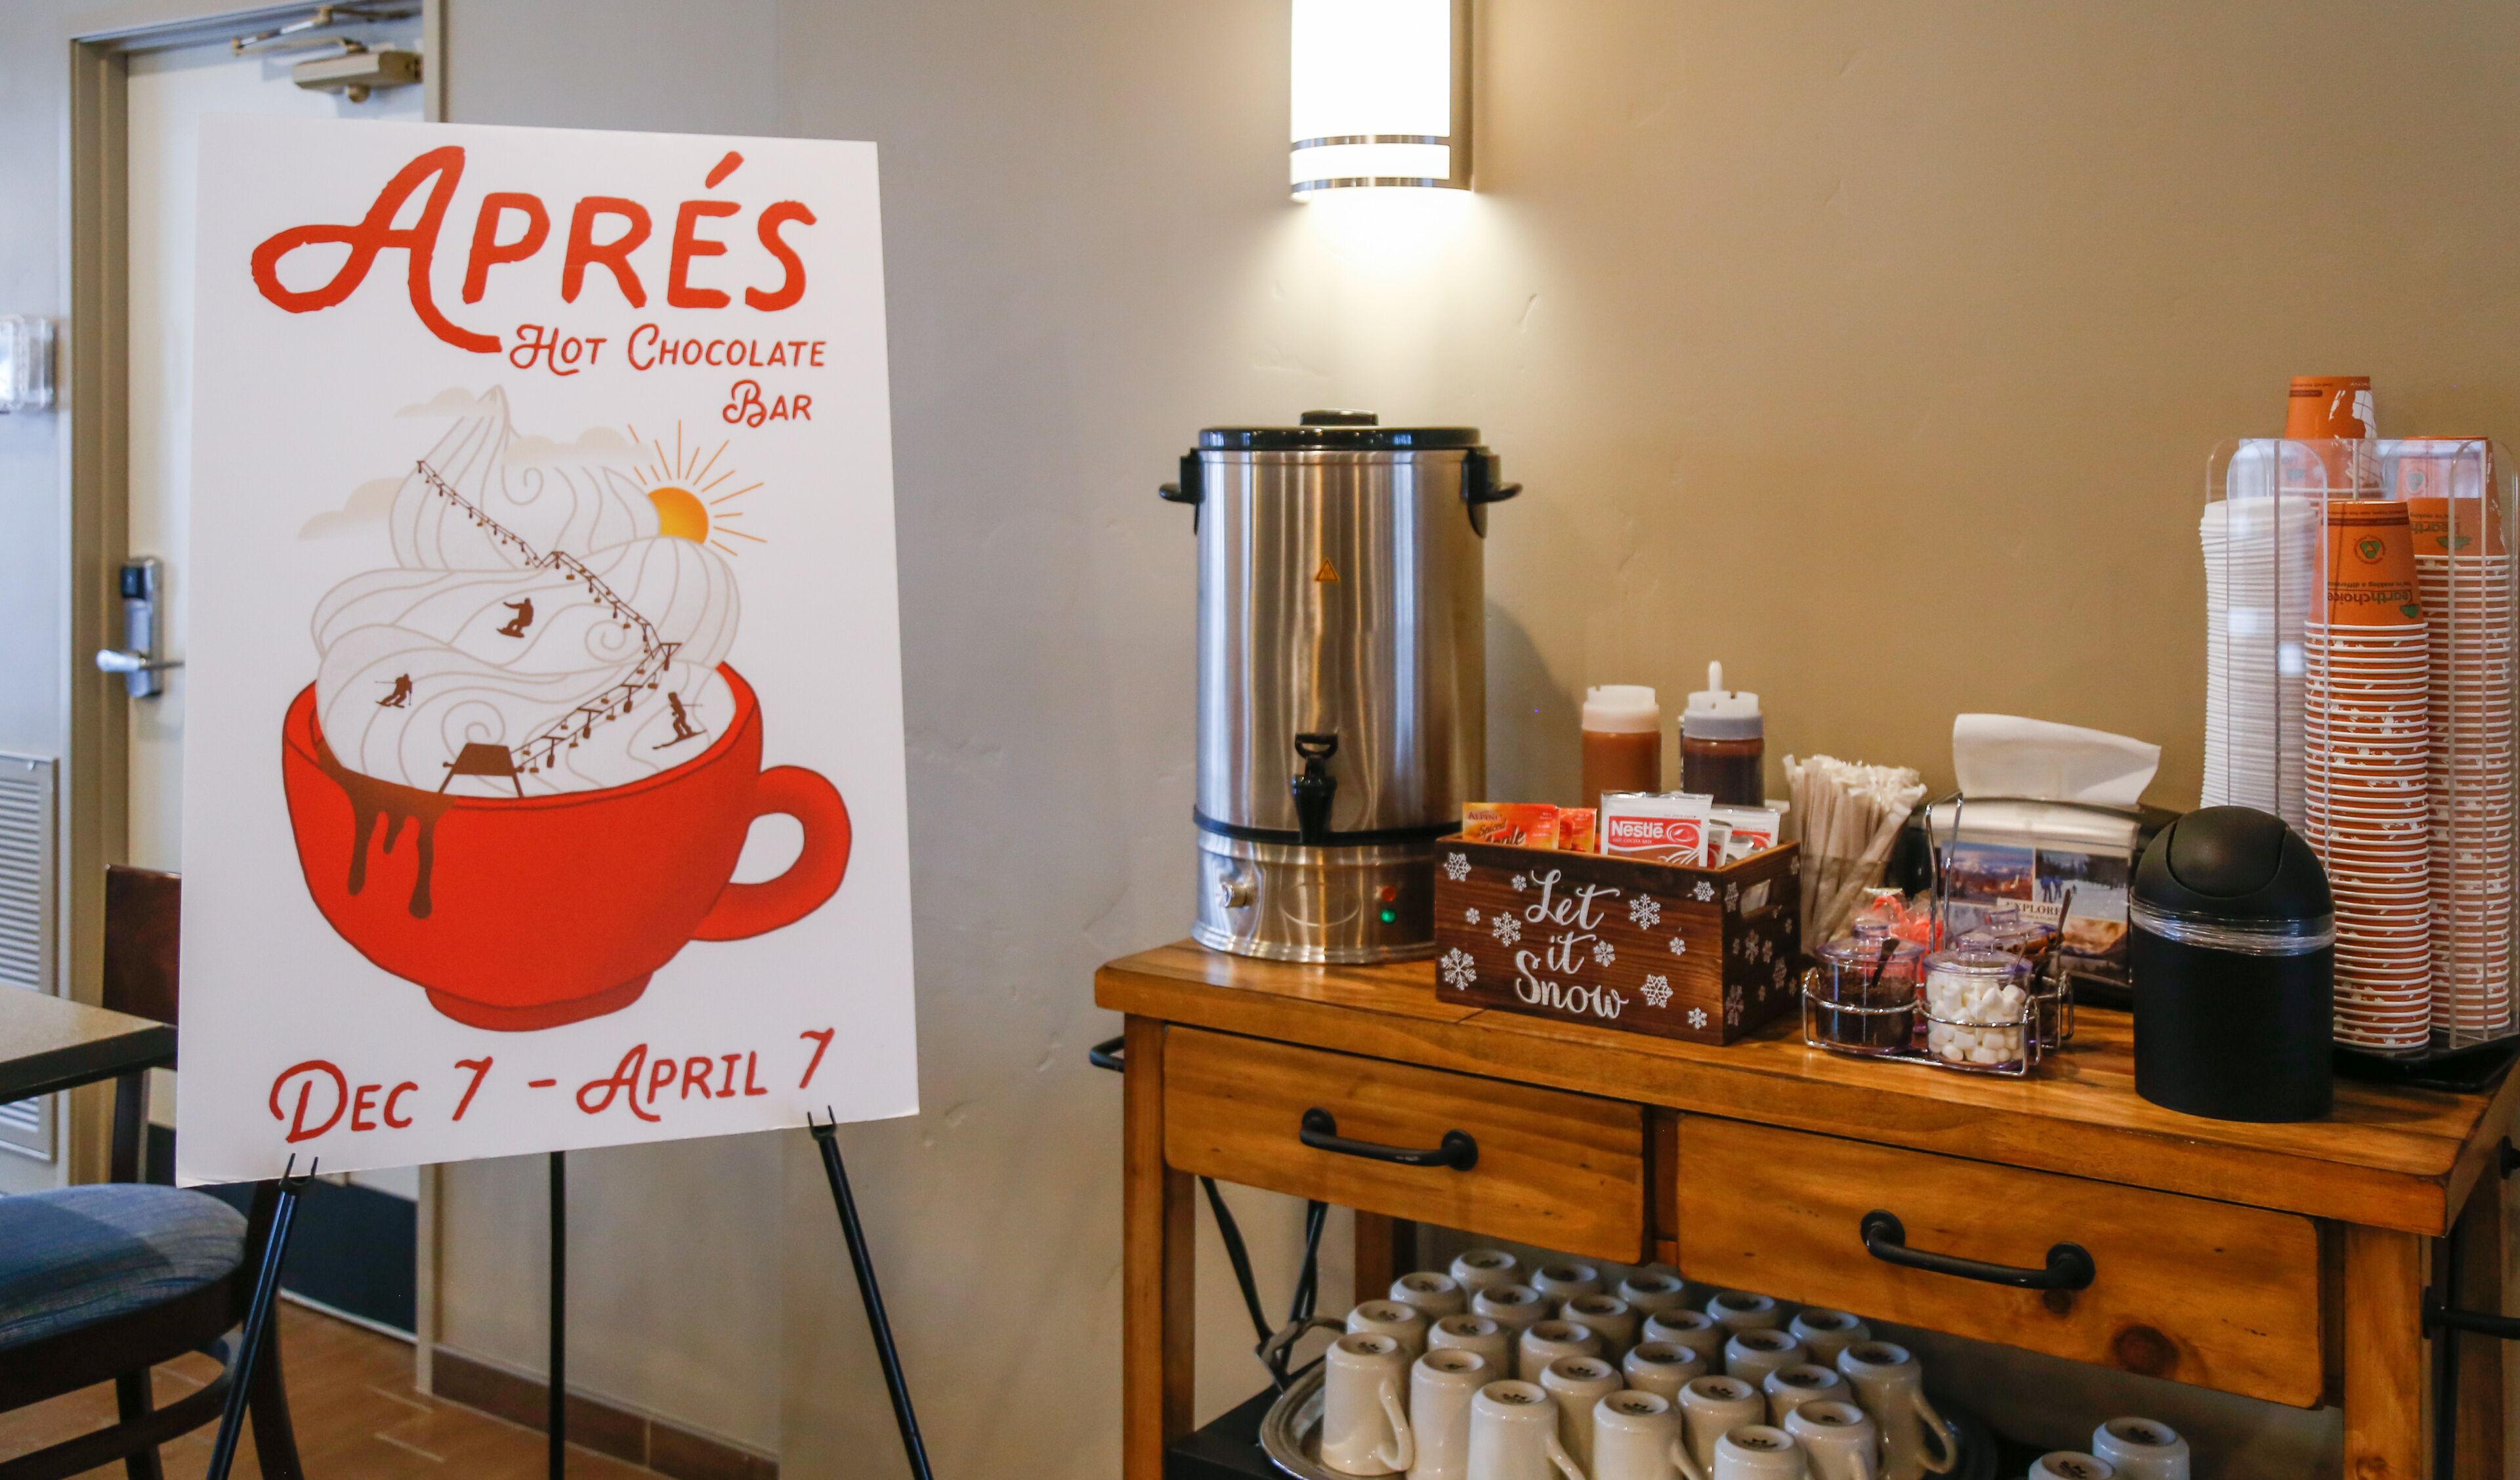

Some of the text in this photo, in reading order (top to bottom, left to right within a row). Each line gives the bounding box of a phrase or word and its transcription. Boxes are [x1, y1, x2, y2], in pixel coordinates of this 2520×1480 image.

[509, 323, 826, 377] HOT CHOCOLATE
[723, 379, 812, 429] BAR
[1479, 818, 1507, 838] Spiced
[1524, 869, 1620, 931] Let
[1547, 931, 1597, 975] it
[1515, 950, 1629, 1019] Snow
[269, 1060, 419, 1143] DEC
[452, 1056, 494, 1121] 7
[576, 1044, 768, 1123] APRIL
[800, 1028, 835, 1089] 7
